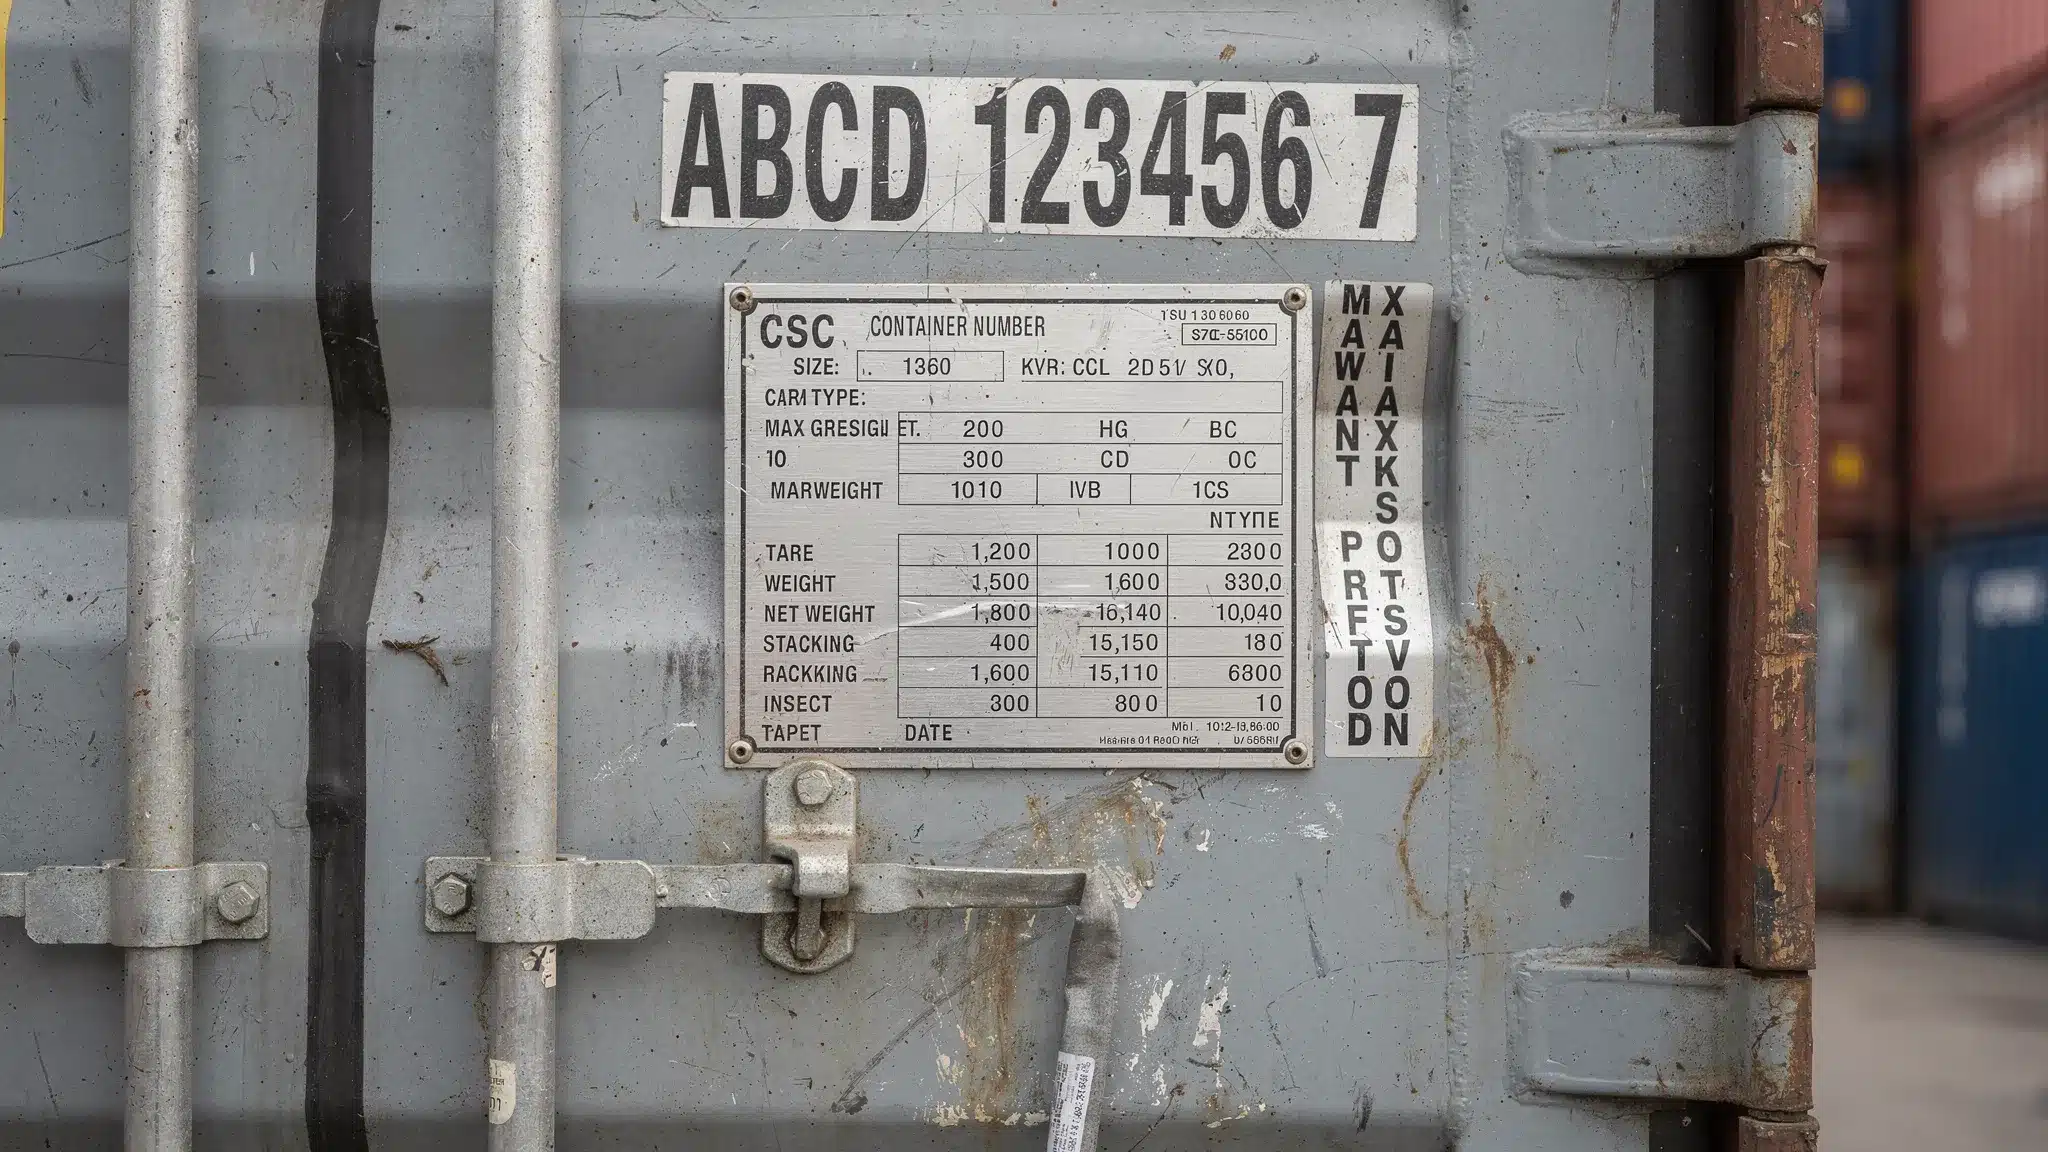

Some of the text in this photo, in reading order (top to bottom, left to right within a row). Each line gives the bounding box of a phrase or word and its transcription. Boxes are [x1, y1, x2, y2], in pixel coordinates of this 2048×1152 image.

[671, 81, 1403, 230] ABCD 123456 7
[760, 314, 1046, 349] CSC CONTAINER NUMBER
[793, 357, 839, 376] SIZE:
[903, 357, 951, 376] 1360
[1021, 358, 1066, 376] KVR:
[1072, 358, 1111, 376] CCL
[811, 388, 866, 407] TYPE:
[765, 419, 805, 437] MAX
[963, 420, 1004, 438] 200
[1099, 420, 1128, 438] HG
[1209, 420, 1237, 438] BC
[963, 450, 1004, 468] 300
[1100, 450, 1129, 468] CD
[771, 481, 1229, 500] MARWEIGHT 1010 IVB 1CS
[765, 544, 814, 562] TARE
[972, 542, 1031, 563] 1,200
[1104, 542, 1160, 560] 1000
[764, 574, 836, 593] WEIGHT
[972, 573, 1030, 593] 1,500
[764, 603, 1282, 624] NET WEIGHT 1,800 16,140 10,040
[763, 633, 1282, 654] STACKING 400 15,150 180
[763, 665, 857, 683] RACKKING
[970, 664, 1030, 685] 1,600
[1088, 664, 1158, 684] 15,110
[764, 694, 1282, 713] INSECT 300 800 10
[762, 724, 822, 742] TAPET
[904, 724, 953, 742] DATE
